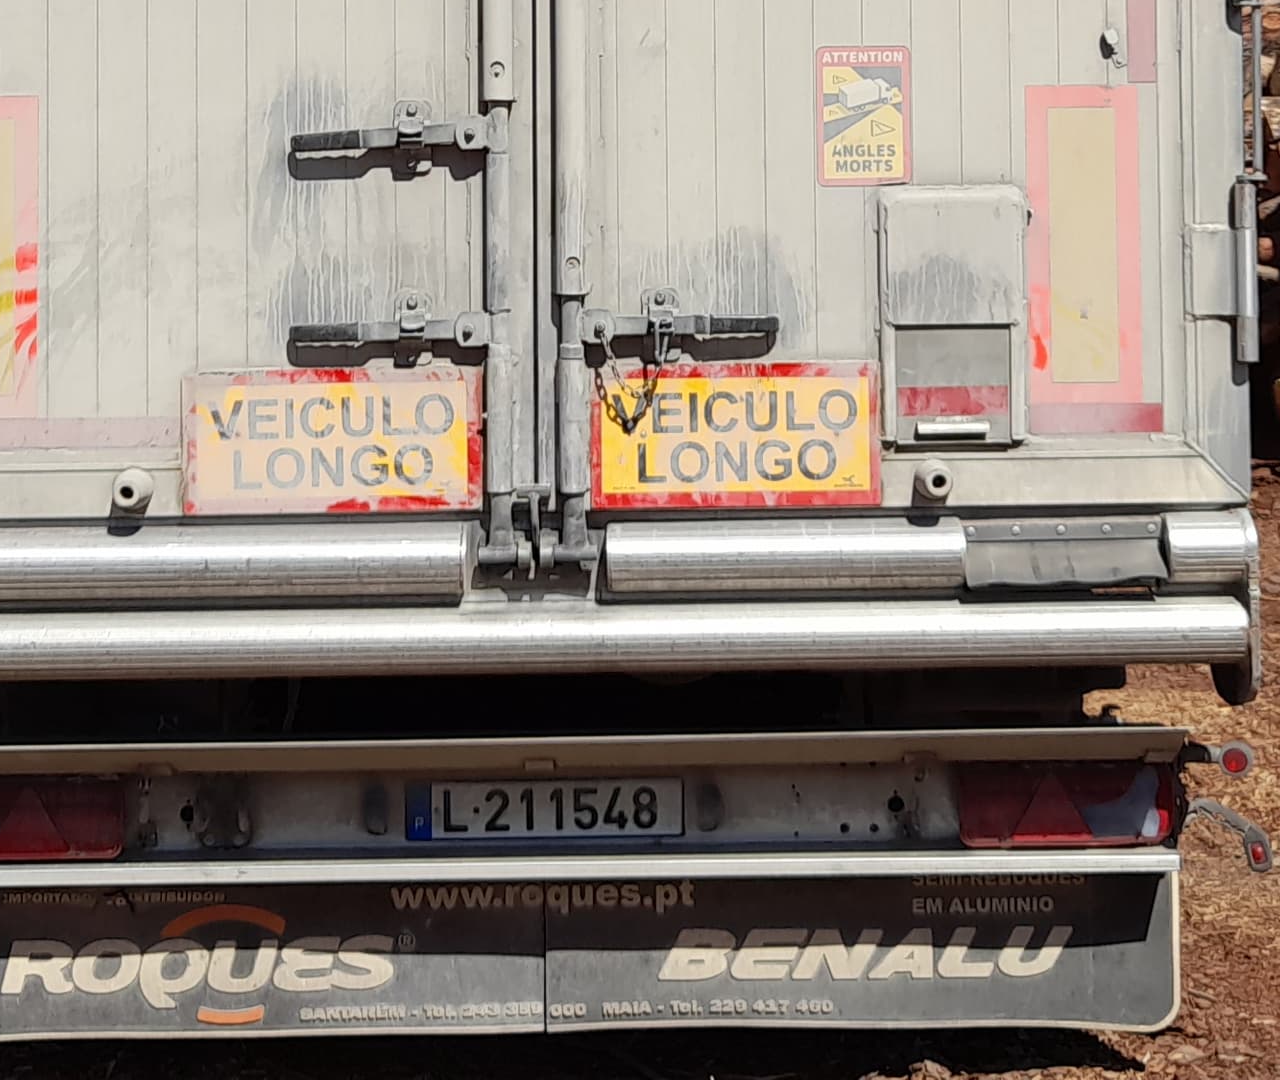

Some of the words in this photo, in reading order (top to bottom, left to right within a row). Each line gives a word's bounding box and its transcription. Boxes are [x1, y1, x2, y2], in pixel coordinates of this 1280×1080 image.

[822, 51, 903, 63] ATTENTION
[832, 144, 896, 157] ANGLES
[835, 160, 893, 172] MORTS
[209, 393, 454, 440] VEICULO
[611, 389, 857, 434] VEICULO
[233, 443, 433, 489] LONGO
[637, 439, 837, 483] LONGO
[391, 880, 695, 913] www.roques.pt
[912, 898, 943, 914] EM
[1, 935, 395, 1009] ROQUES
[658, 926, 1073, 981] BENALU
[602, 1001, 652, 1019] MAIA
